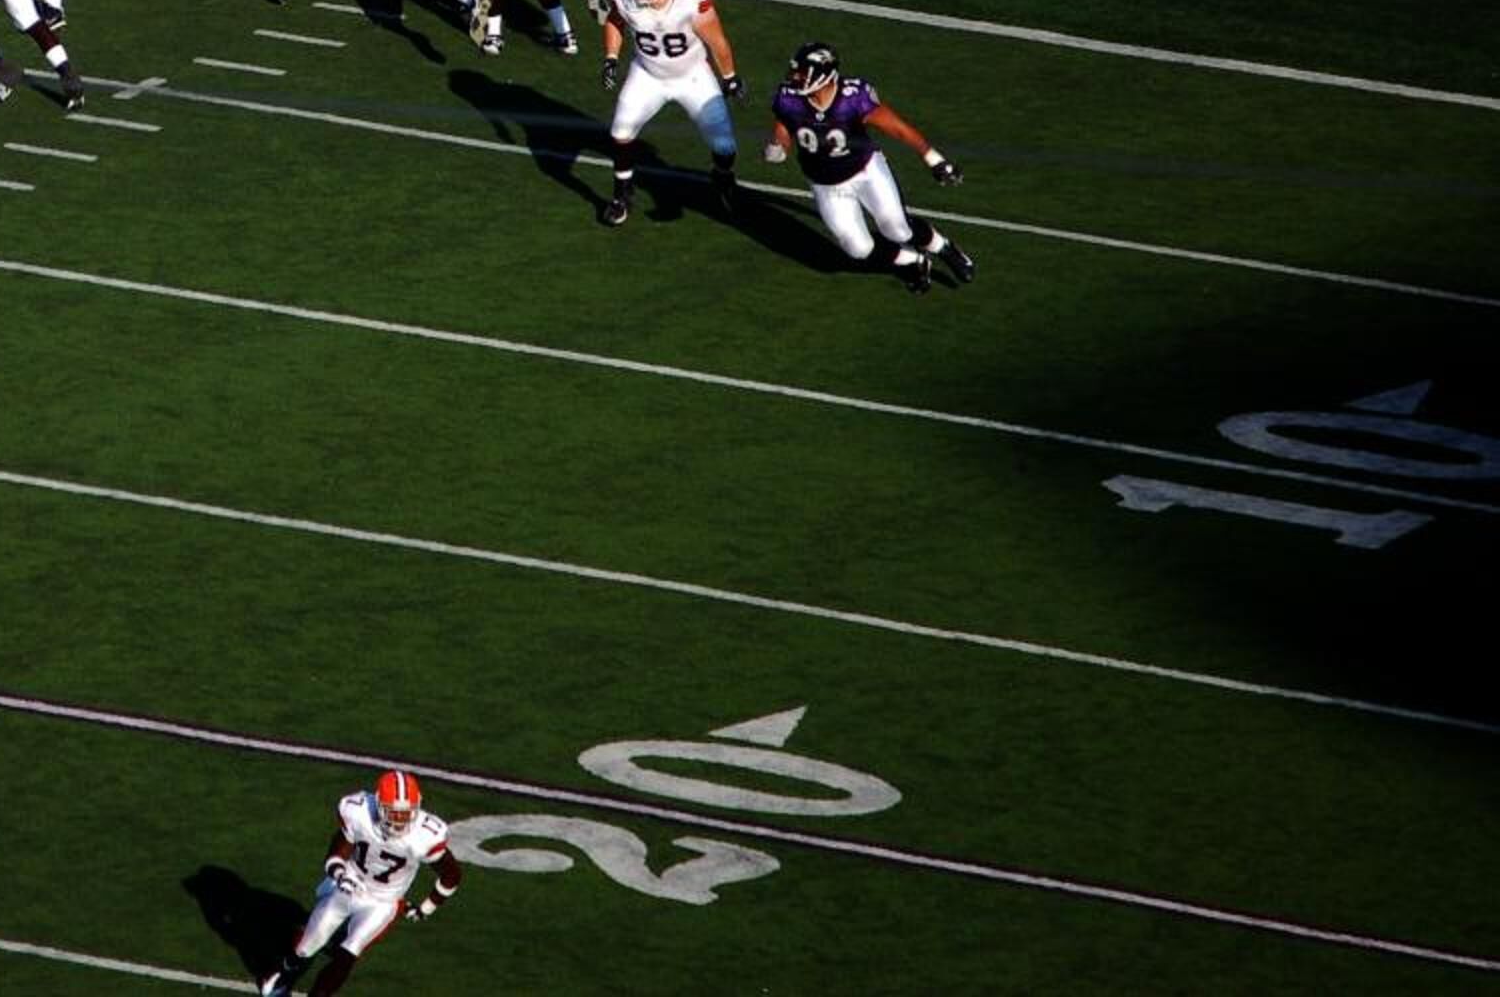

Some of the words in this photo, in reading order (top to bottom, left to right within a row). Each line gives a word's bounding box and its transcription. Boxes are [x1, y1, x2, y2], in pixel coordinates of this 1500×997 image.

[635, 31, 688, 58] 68
[797, 127, 850, 157] 92
[355, 840, 407, 884] 17
